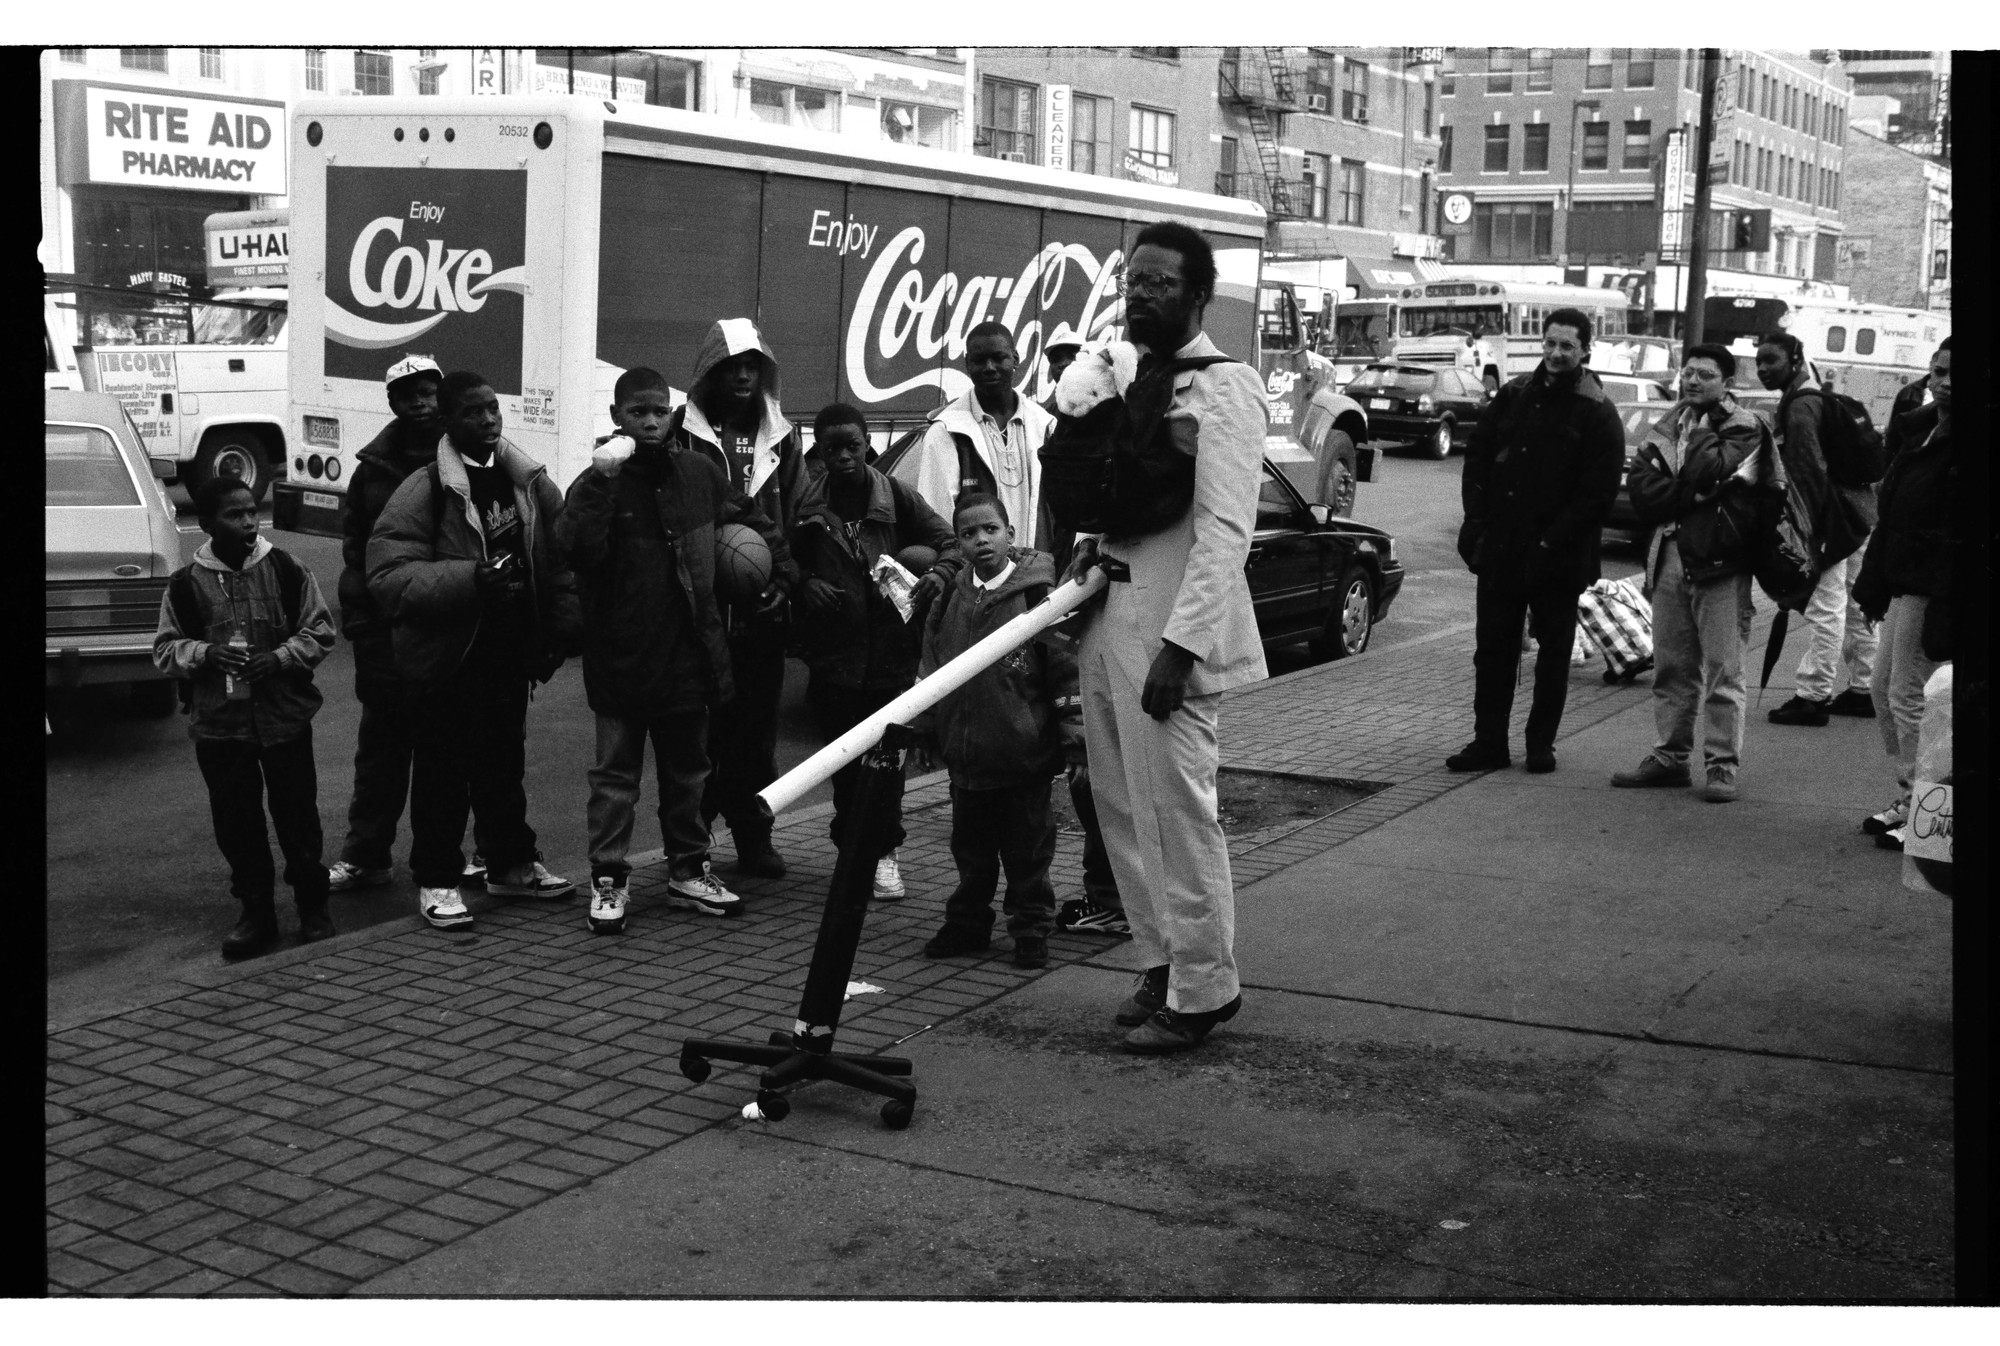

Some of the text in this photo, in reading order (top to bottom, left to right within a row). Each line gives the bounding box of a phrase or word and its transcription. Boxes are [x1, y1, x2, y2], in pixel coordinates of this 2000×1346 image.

[600, 79, 645, 97] WAVING
[105, 100, 271, 150] RITE AID
[499, 125, 529, 138] 20532
[1051, 90, 1064, 170] CLEANER
[122, 150, 256, 182] PHARMACY
[409, 201, 445, 223] Enjoy
[808, 209, 878, 259] Enjoy
[233, 266, 255, 276] FINEST
[257, 265, 284, 275] MOVING
[349, 216, 493, 313] Coke
[130, 271, 187, 287] HAPPY EASTER
[525, 387, 555, 397] THIS TRUCK
[523, 405, 556, 417] WIDE RIGHT
[523, 416, 555, 427] HAND TURNS
